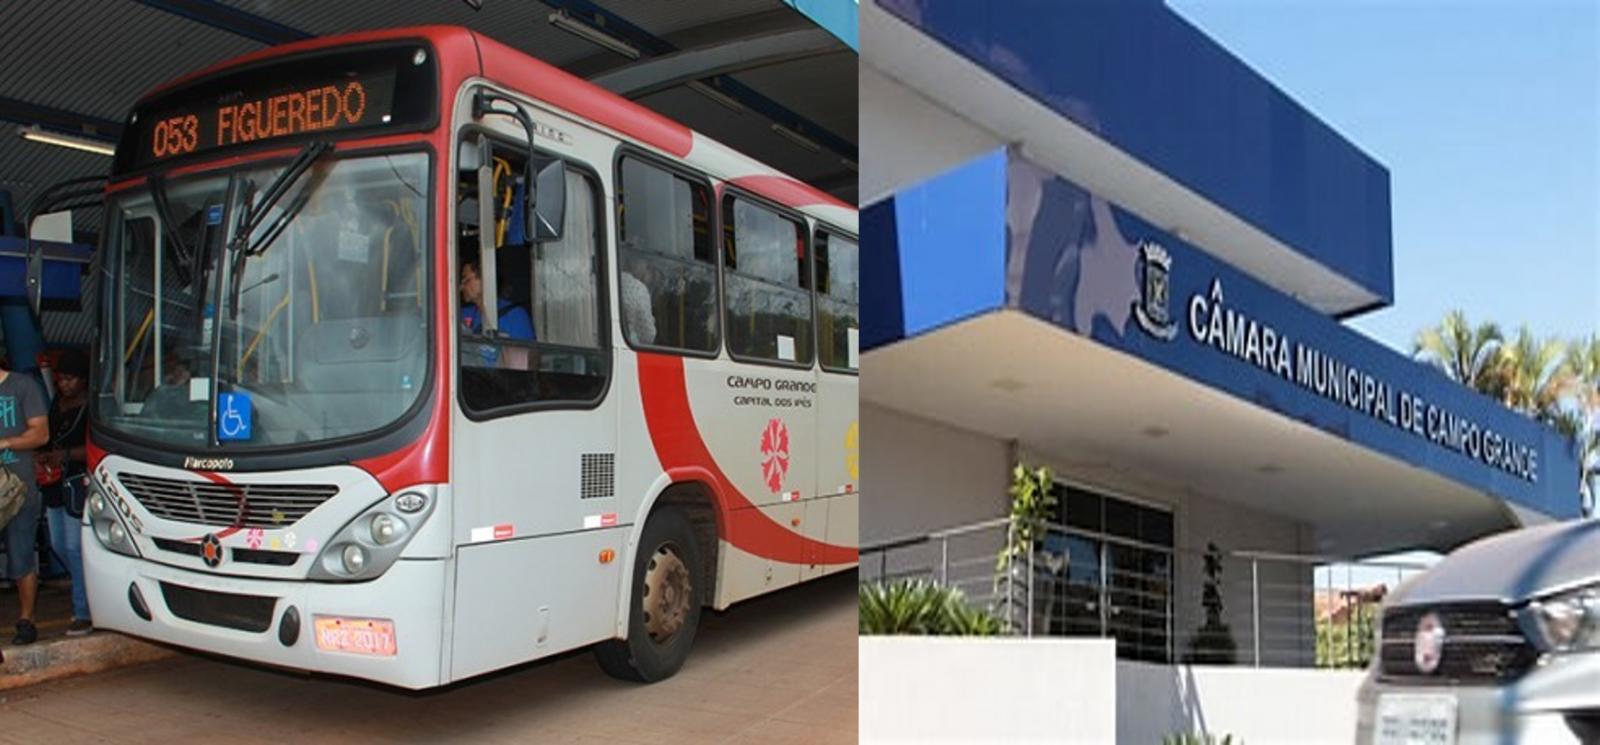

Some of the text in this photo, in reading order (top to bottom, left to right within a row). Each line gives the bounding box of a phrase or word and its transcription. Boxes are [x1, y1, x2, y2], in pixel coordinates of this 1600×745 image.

[153, 81, 366, 157] 053 FIGUEREDO
[1189, 277, 1538, 483] CÂMARA MUNICIPAL DE CAMPO GRANDE
[184, 456, 234, 470] Marcopolo
